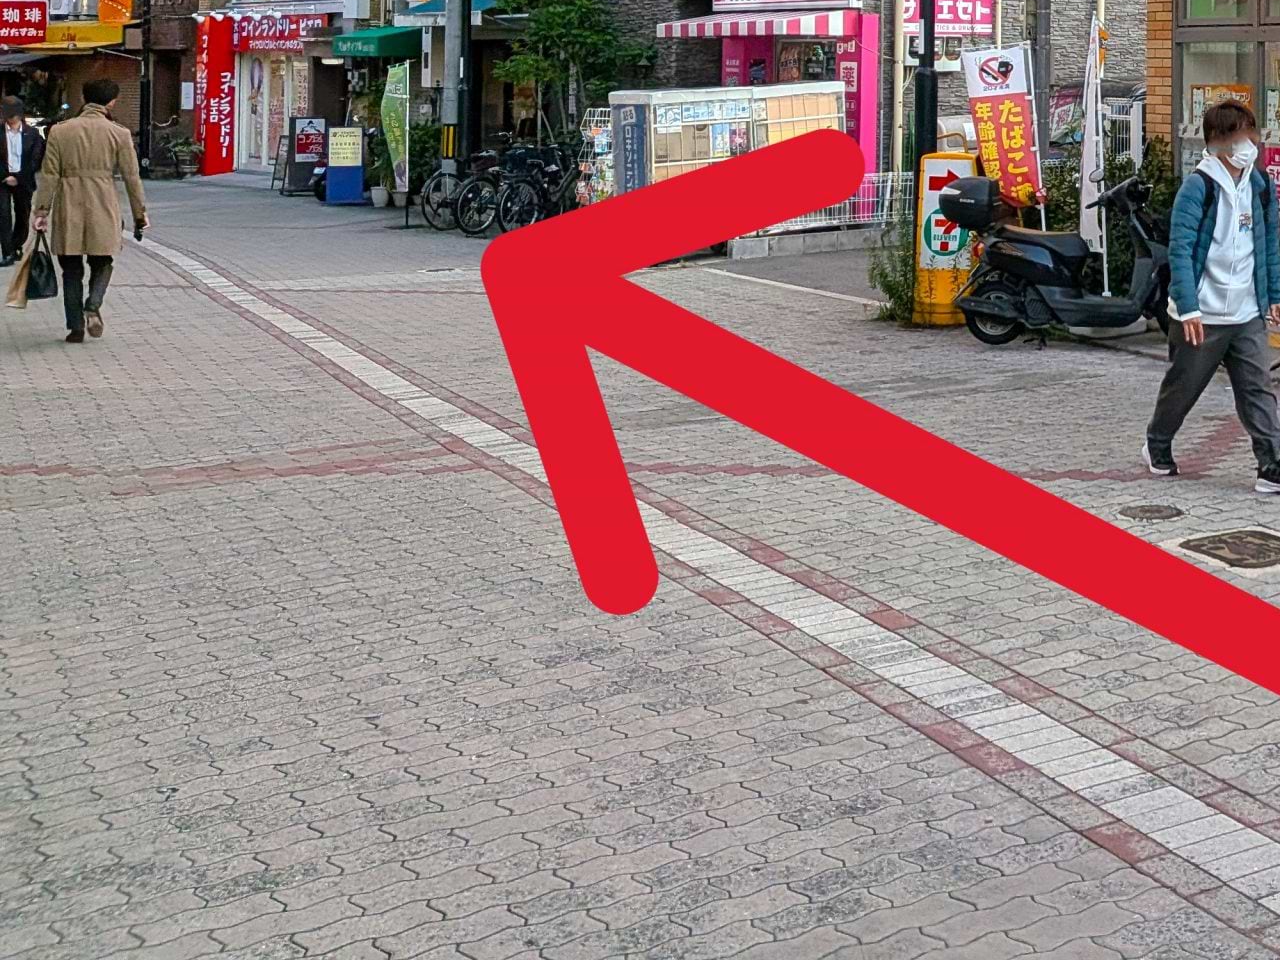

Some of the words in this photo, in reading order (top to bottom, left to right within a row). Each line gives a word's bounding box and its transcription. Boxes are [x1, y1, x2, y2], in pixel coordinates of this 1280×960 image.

[2, 7, 42, 23] 珈琲
[241, 19, 297, 37] コインランドリー
[210, 97, 219, 123] ピエロ
[219, 72, 231, 158] コインランドリー
